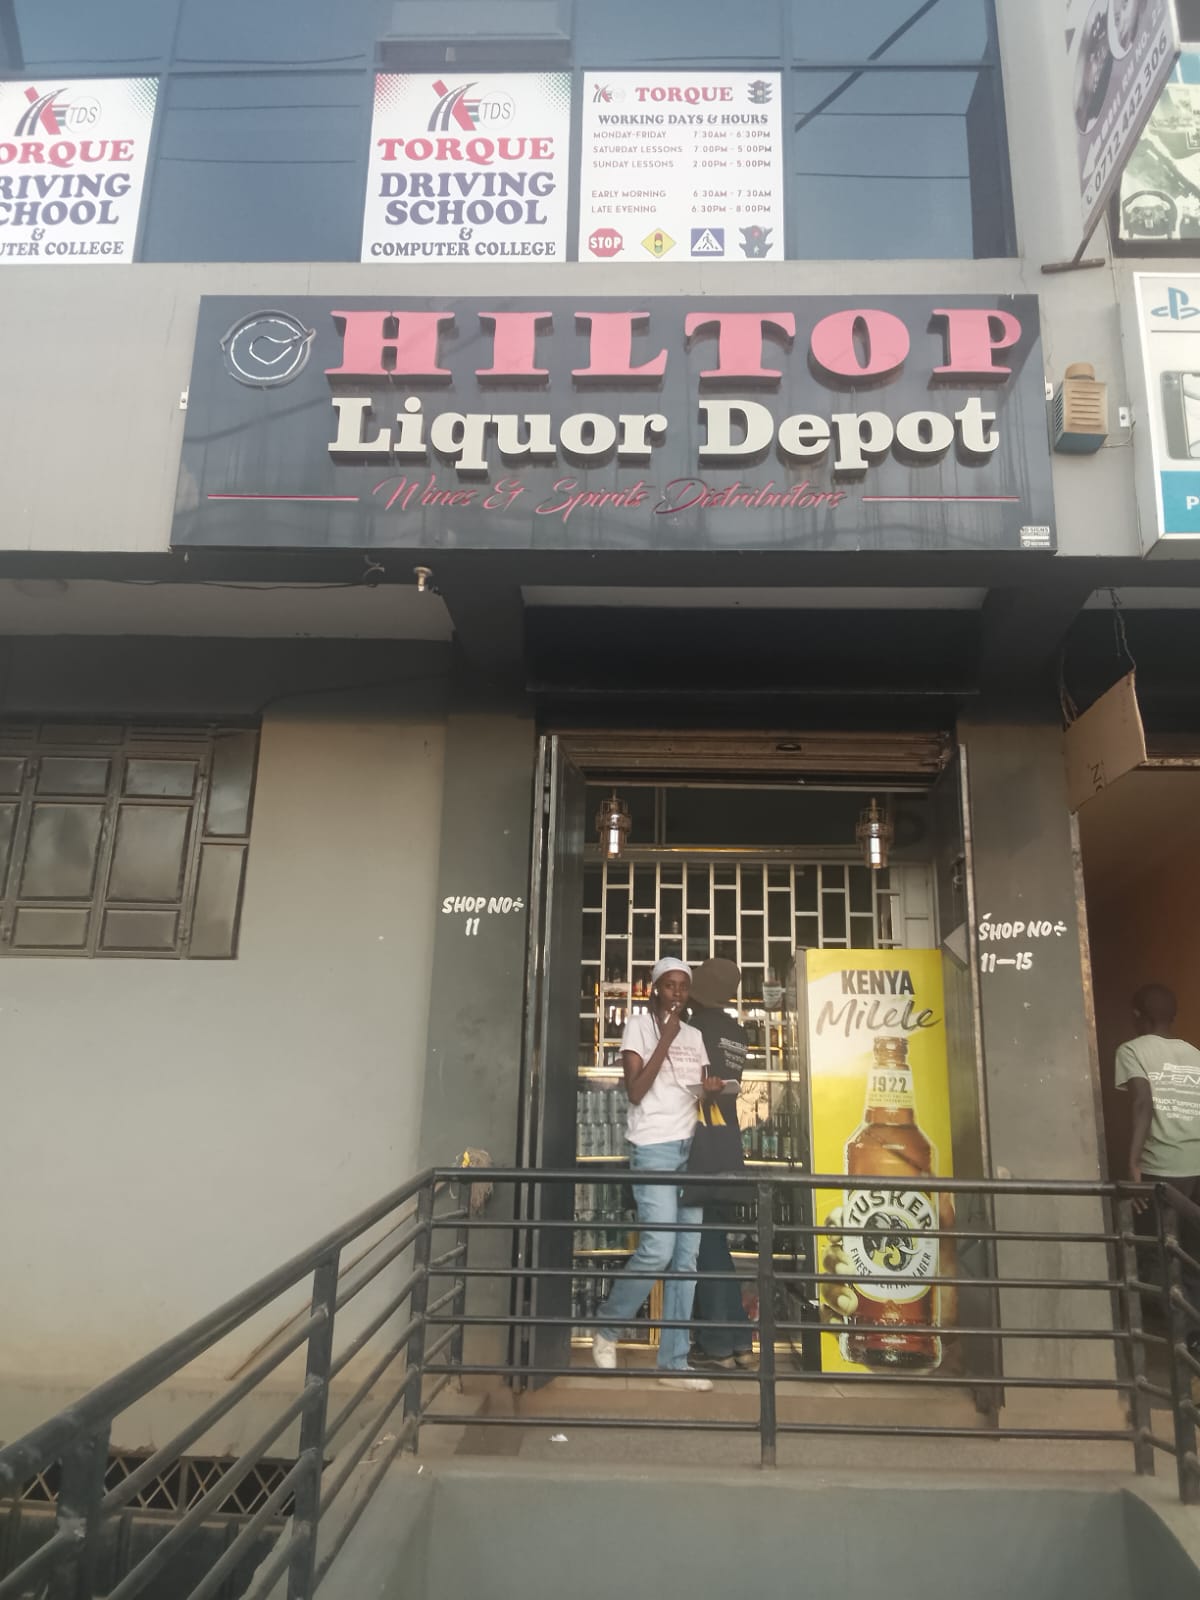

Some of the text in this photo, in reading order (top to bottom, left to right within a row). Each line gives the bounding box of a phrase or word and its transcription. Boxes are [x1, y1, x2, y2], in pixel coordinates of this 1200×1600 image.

[634, 86, 734, 105] TORQUE
[69, 106, 98, 124] TDS
[482, 102, 511, 120] TDS
[598, 114, 769, 125] WORKING DAYS & HOURS
[1095, 130, 1121, 193] 0712
[1143, 29, 1168, 89] 306
[593, 130, 667, 139] MONDAY-FRIDAY
[377, 137, 555, 166] TORQUE
[593, 145, 638, 154] SATURDAY
[640, 145, 684, 153] LESSONS
[592, 160, 629, 169] SUNDAY
[632, 160, 675, 168] LESSONS
[378, 171, 556, 198] DRIVING
[591, 189, 619, 198] EARLY
[621, 189, 667, 198] MORNING
[384, 199, 548, 226] SCHOOL
[591, 205, 613, 213] LATE
[615, 205, 657, 213] EVENING
[31, 228, 45, 241] &
[459, 227, 473, 241] &
[590, 236, 622, 249] STOP
[44, 241, 124, 255] COLLEGE
[370, 241, 556, 257] COMPUTER COLLEGE
[324, 308, 1023, 378] HILTOP
[327, 396, 1000, 470] Liquor Depot
[372, 474, 844, 524] Wines & Spirits Distributors
[1185, 495, 1200, 511] P
[441, 896, 486, 914] SHOP
[465, 918, 480, 936] 11
[979, 920, 1025, 941] SHOP
[841, 969, 916, 995] KENYA
[815, 999, 943, 1038] Milele
[873, 1076, 908, 1094] 1922
[848, 1188, 933, 1231] TUSKER
[911, 1251, 933, 1278] LAGER
